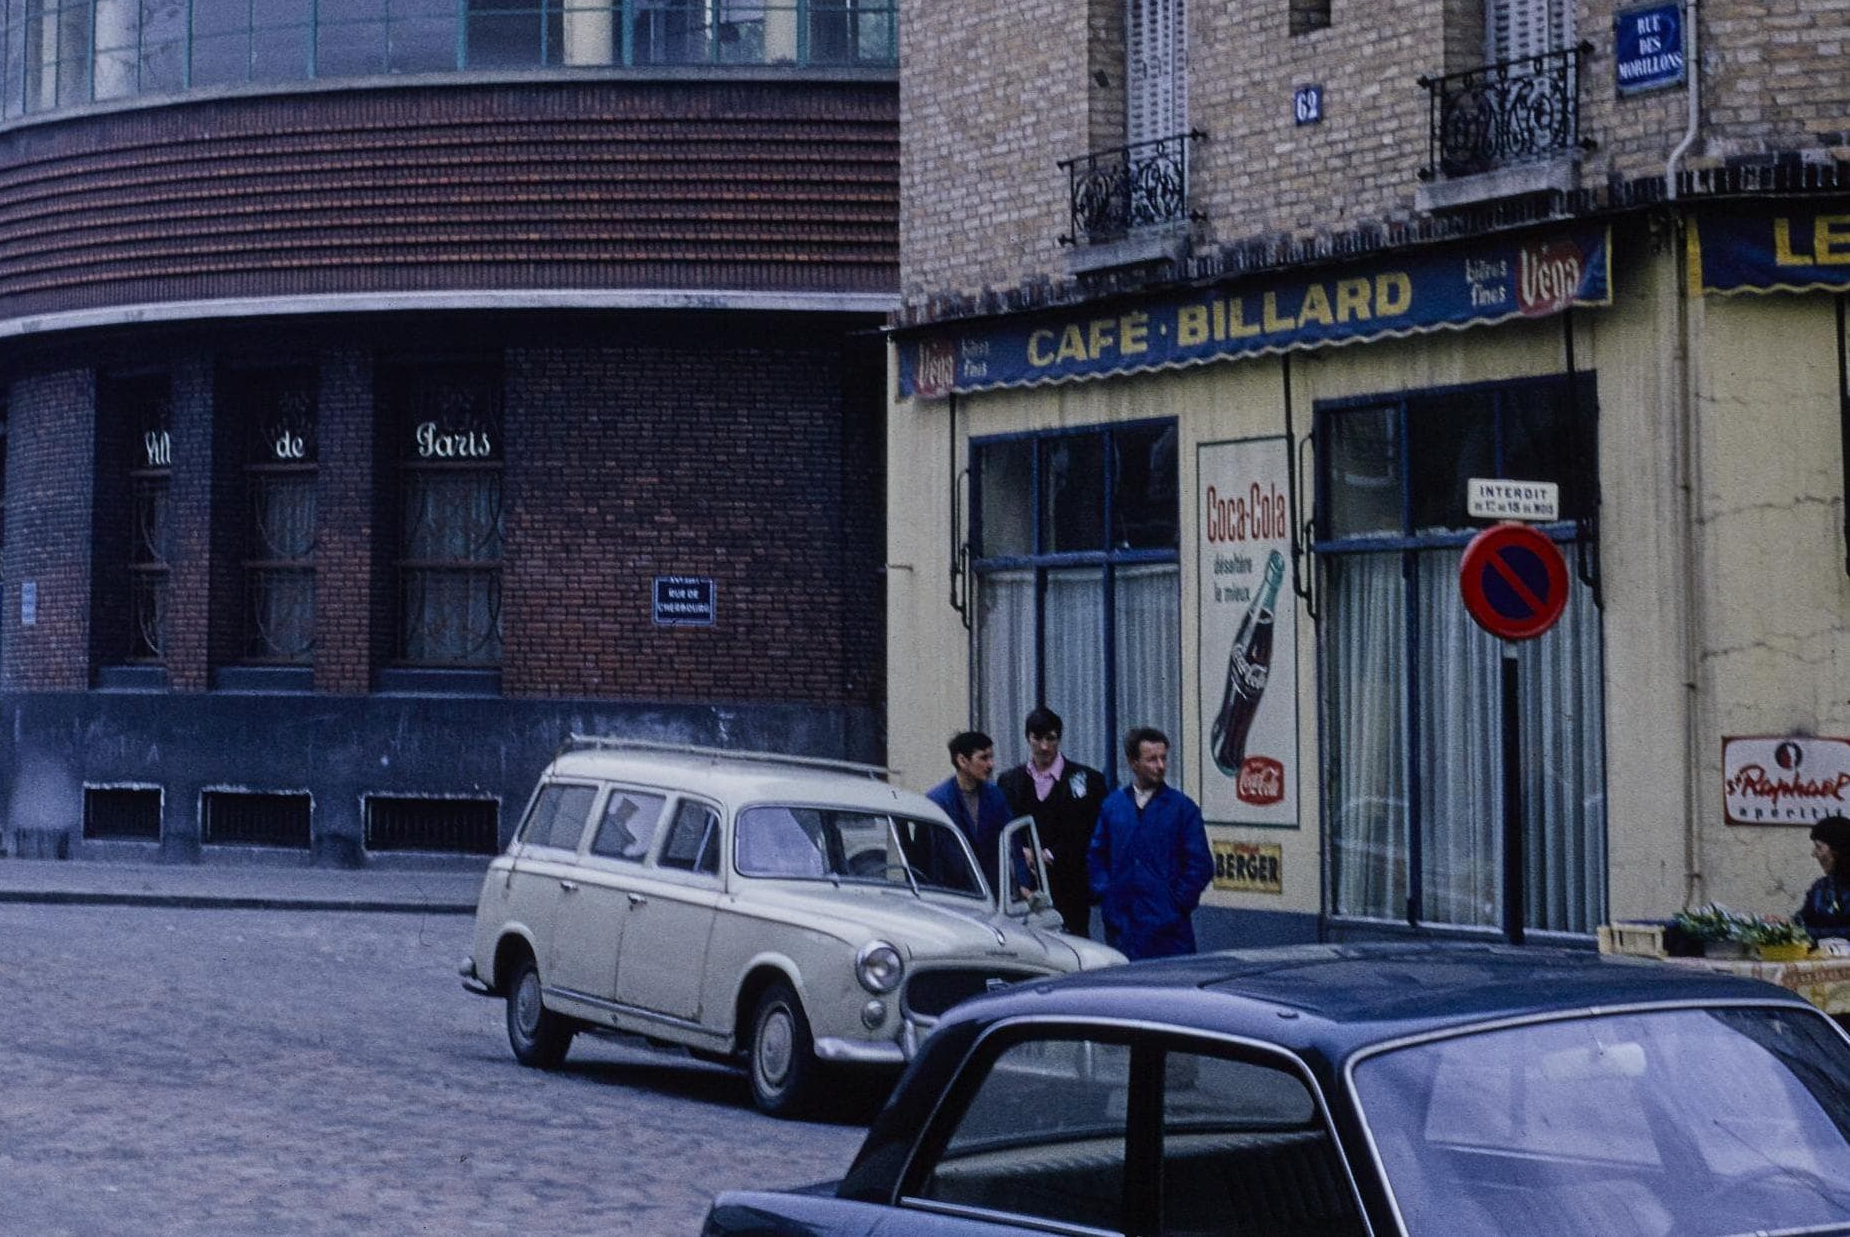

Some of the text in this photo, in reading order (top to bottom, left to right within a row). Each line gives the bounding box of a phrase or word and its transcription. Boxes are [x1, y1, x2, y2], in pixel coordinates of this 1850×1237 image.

[1637, 13, 1660, 35] RUE
[1618, 50, 1683, 79] MORILLONS
[1297, 90, 1317, 121] 62
[1177, 271, 1412, 347] BILLARD
[145, 421, 491, 465] Vill de Paris
[1479, 485, 1547, 500] INTERDIT
[1207, 481, 1286, 544] Coca-Cola
[1215, 852, 1279, 884] BERGER
